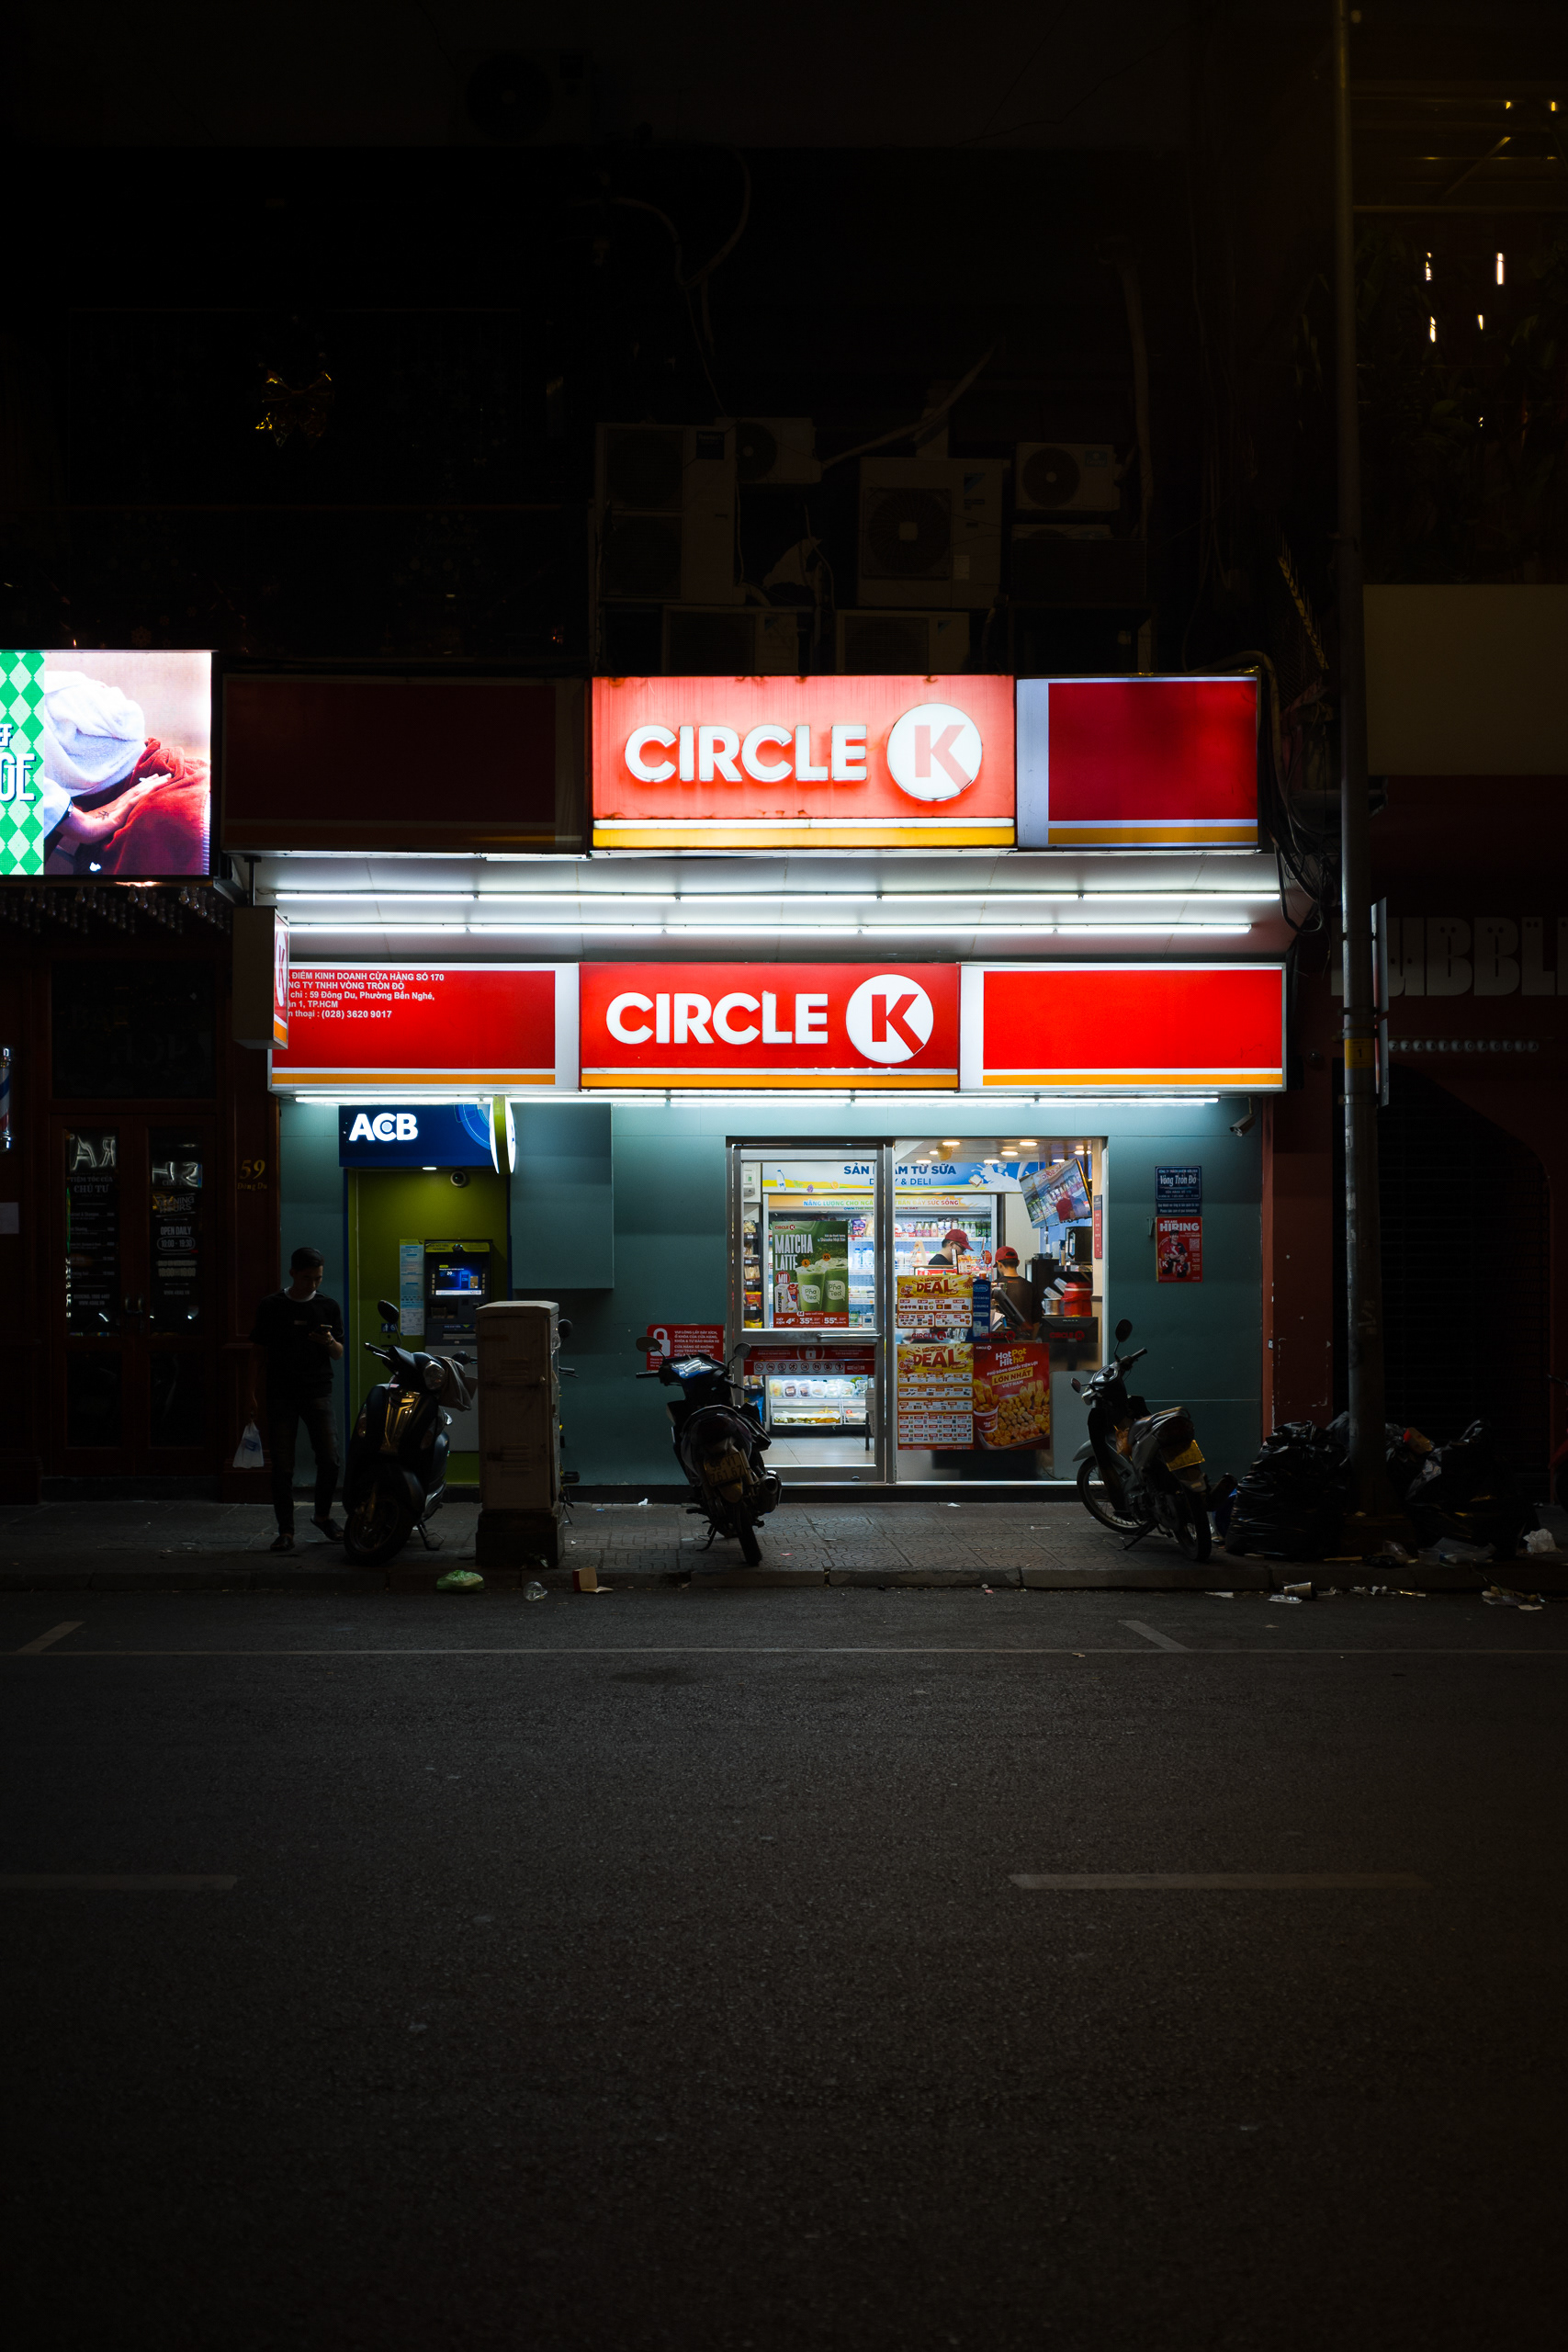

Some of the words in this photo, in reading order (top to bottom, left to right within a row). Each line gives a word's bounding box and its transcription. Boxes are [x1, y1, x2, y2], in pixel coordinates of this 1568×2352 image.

[625, 724, 867, 783] CIRCLE
[292, 971, 312, 979] ĐIỂM
[314, 971, 335, 980] KINH
[336, 972, 367, 980] DOANH
[369, 972, 388, 981] CỬA
[390, 972, 413, 981] HÀNG
[415, 972, 429, 981] SỐ
[430, 973, 444, 981] 170
[288, 981, 300, 989] NG
[302, 981, 314, 989] TY
[316, 981, 338, 989] TNHH
[339, 980, 365, 989] VÒNG
[367, 981, 390, 989] TRÒN
[391, 981, 404, 989] ĐỎ
[344, 991, 357, 1000] Du,
[359, 991, 391, 1001] Phường
[394, 991, 410, 1000] Bến
[298, 1001, 305, 1009] 1,
[295, 1010, 315, 1019] thoại
[321, 1011, 344, 1019] (028)
[605, 991, 828, 1045] CIRCLE
[1358, 1048, 1362, 1057] 1
[348, 1113, 419, 1142] ACB
[239, 1159, 265, 1180] 59
[844, 1162, 869, 1174] SẢN
[931, 1162, 956, 1174] SỮA
[73, 1183, 93, 1193] CHÚ
[941, 1197, 959, 1205] SỐNG
[160, 1226, 175, 1235] OPEN
[175, 1226, 192, 1235] DAILY
[1159, 1223, 1200, 1232] HIRING
[774, 1234, 814, 1254] MATCHA
[775, 1254, 798, 1271] LATTE
[916, 1279, 953, 1295] DEAL
[913, 1349, 962, 1368] DEAL
[995, 1351, 1012, 1361] Hot
[994, 1375, 1010, 1385] LỚN
[1010, 1367, 1032, 1380] NHẤT
